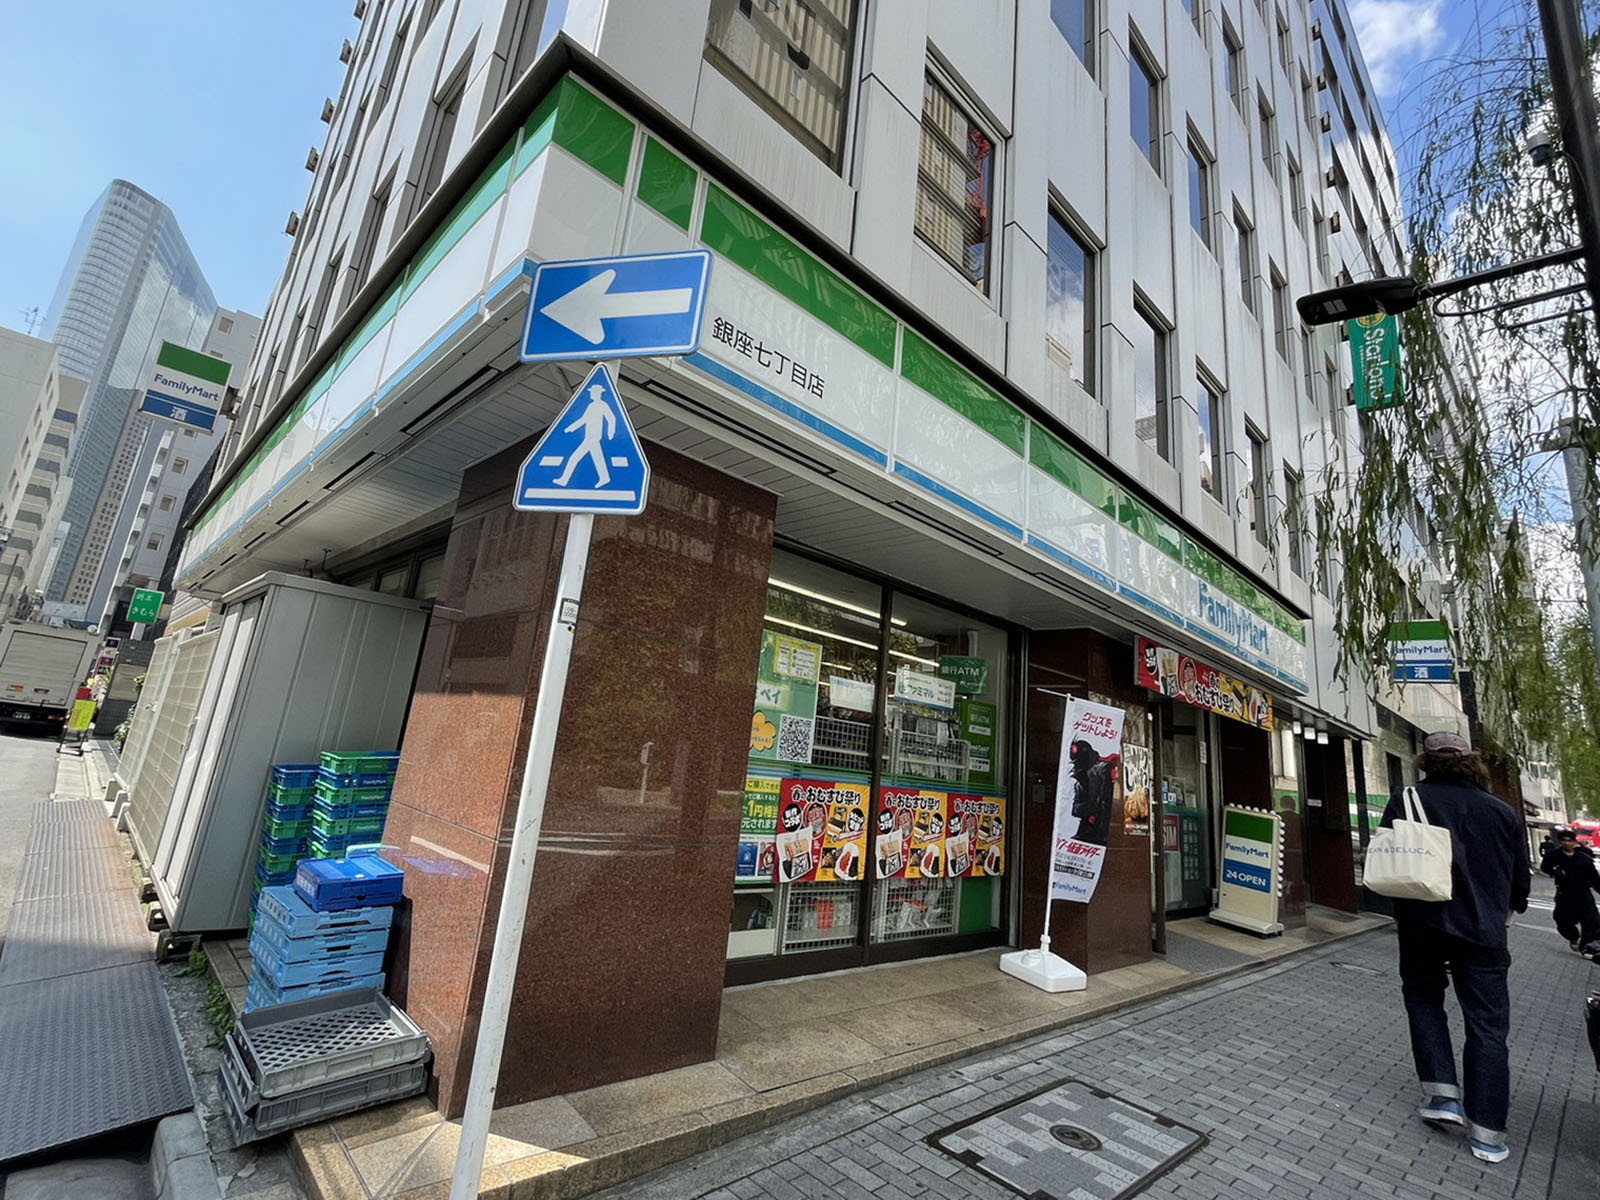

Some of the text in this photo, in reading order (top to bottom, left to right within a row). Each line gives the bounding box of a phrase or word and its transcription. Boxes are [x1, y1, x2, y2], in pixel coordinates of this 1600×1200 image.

[712, 316, 825, 399] 銀座七丁目店
[154, 373, 219, 402] FamilyMart
[170, 406, 188, 421] 酒
[1198, 580, 1270, 656] FamilyMart
[1392, 646, 1449, 655] amilyMart
[1414, 666, 1429, 679] 酒
[1082, 712, 1112, 728] グッズを
[1225, 842, 1270, 859] FamilyMart
[1238, 872, 1267, 887] OPEN
